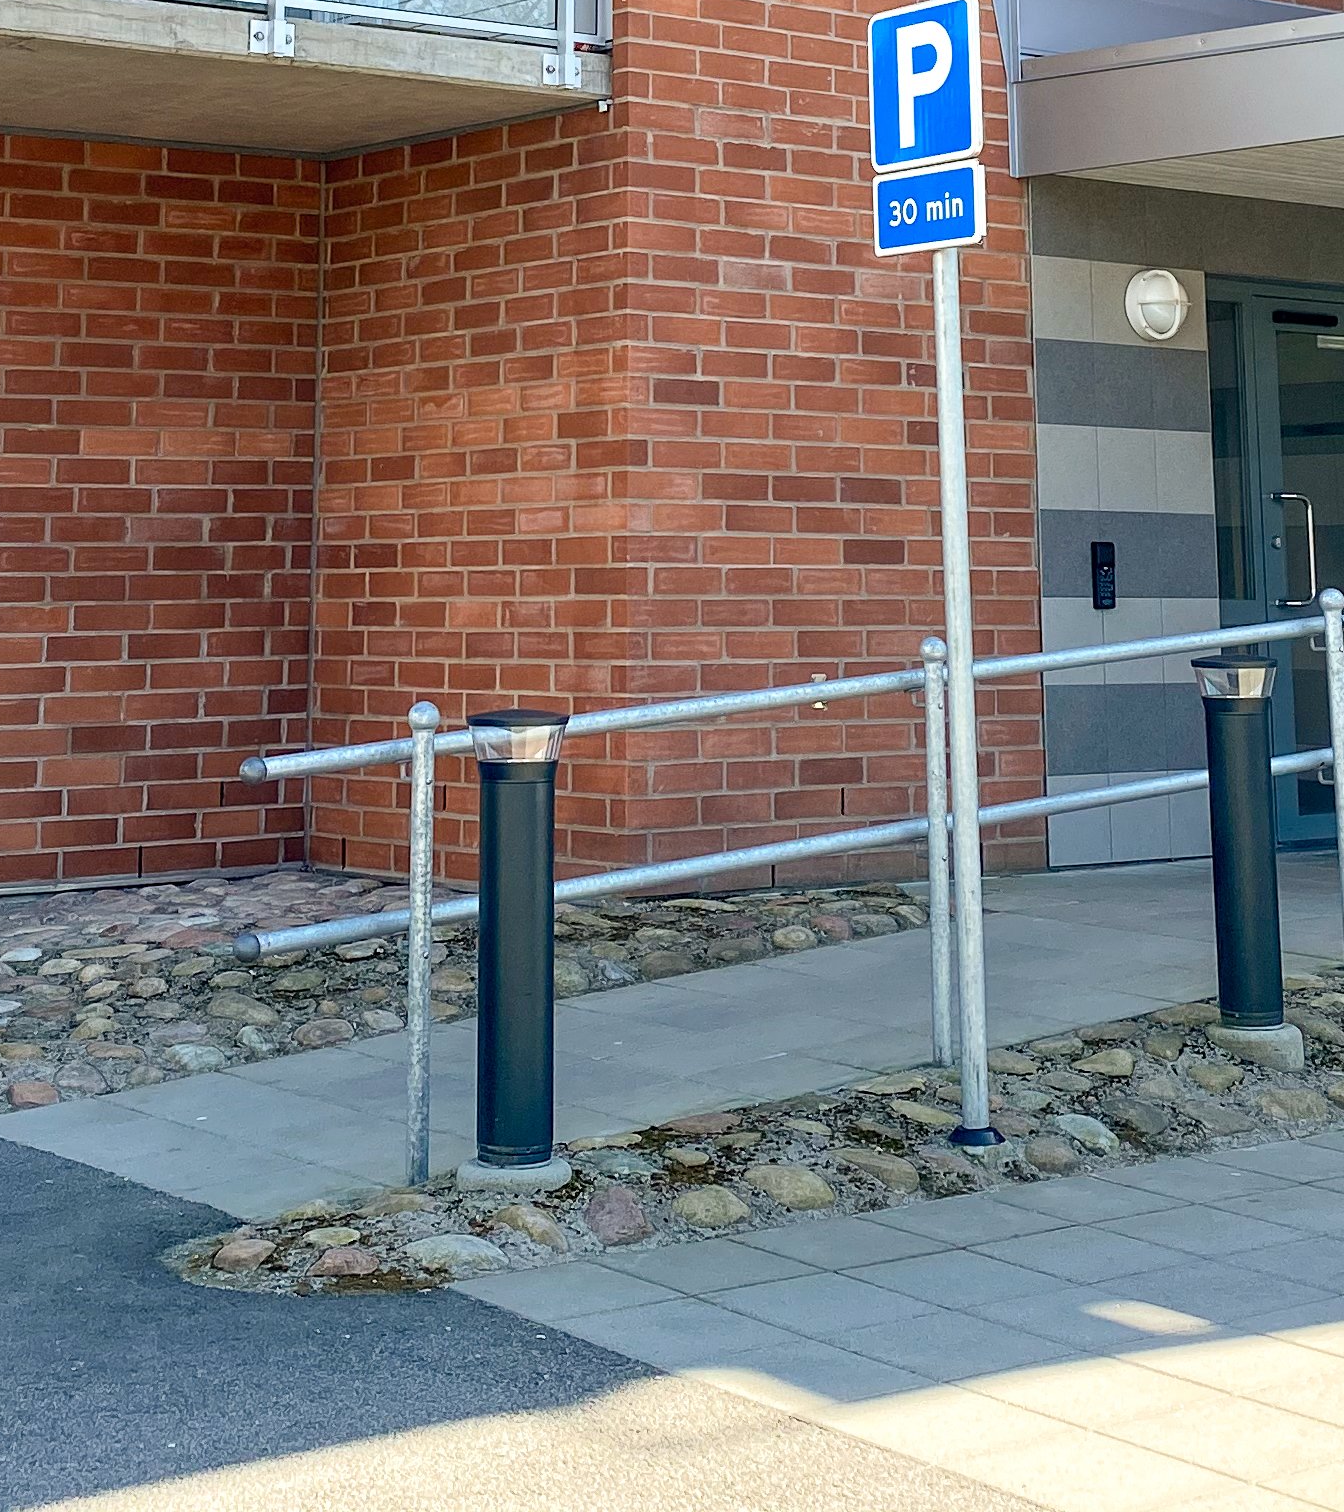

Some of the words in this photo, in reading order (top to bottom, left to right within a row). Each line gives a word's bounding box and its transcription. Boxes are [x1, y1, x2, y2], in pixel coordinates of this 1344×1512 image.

[896, 20, 953, 149] P
[889, 197, 918, 227] 30
[926, 191, 964, 222] min
